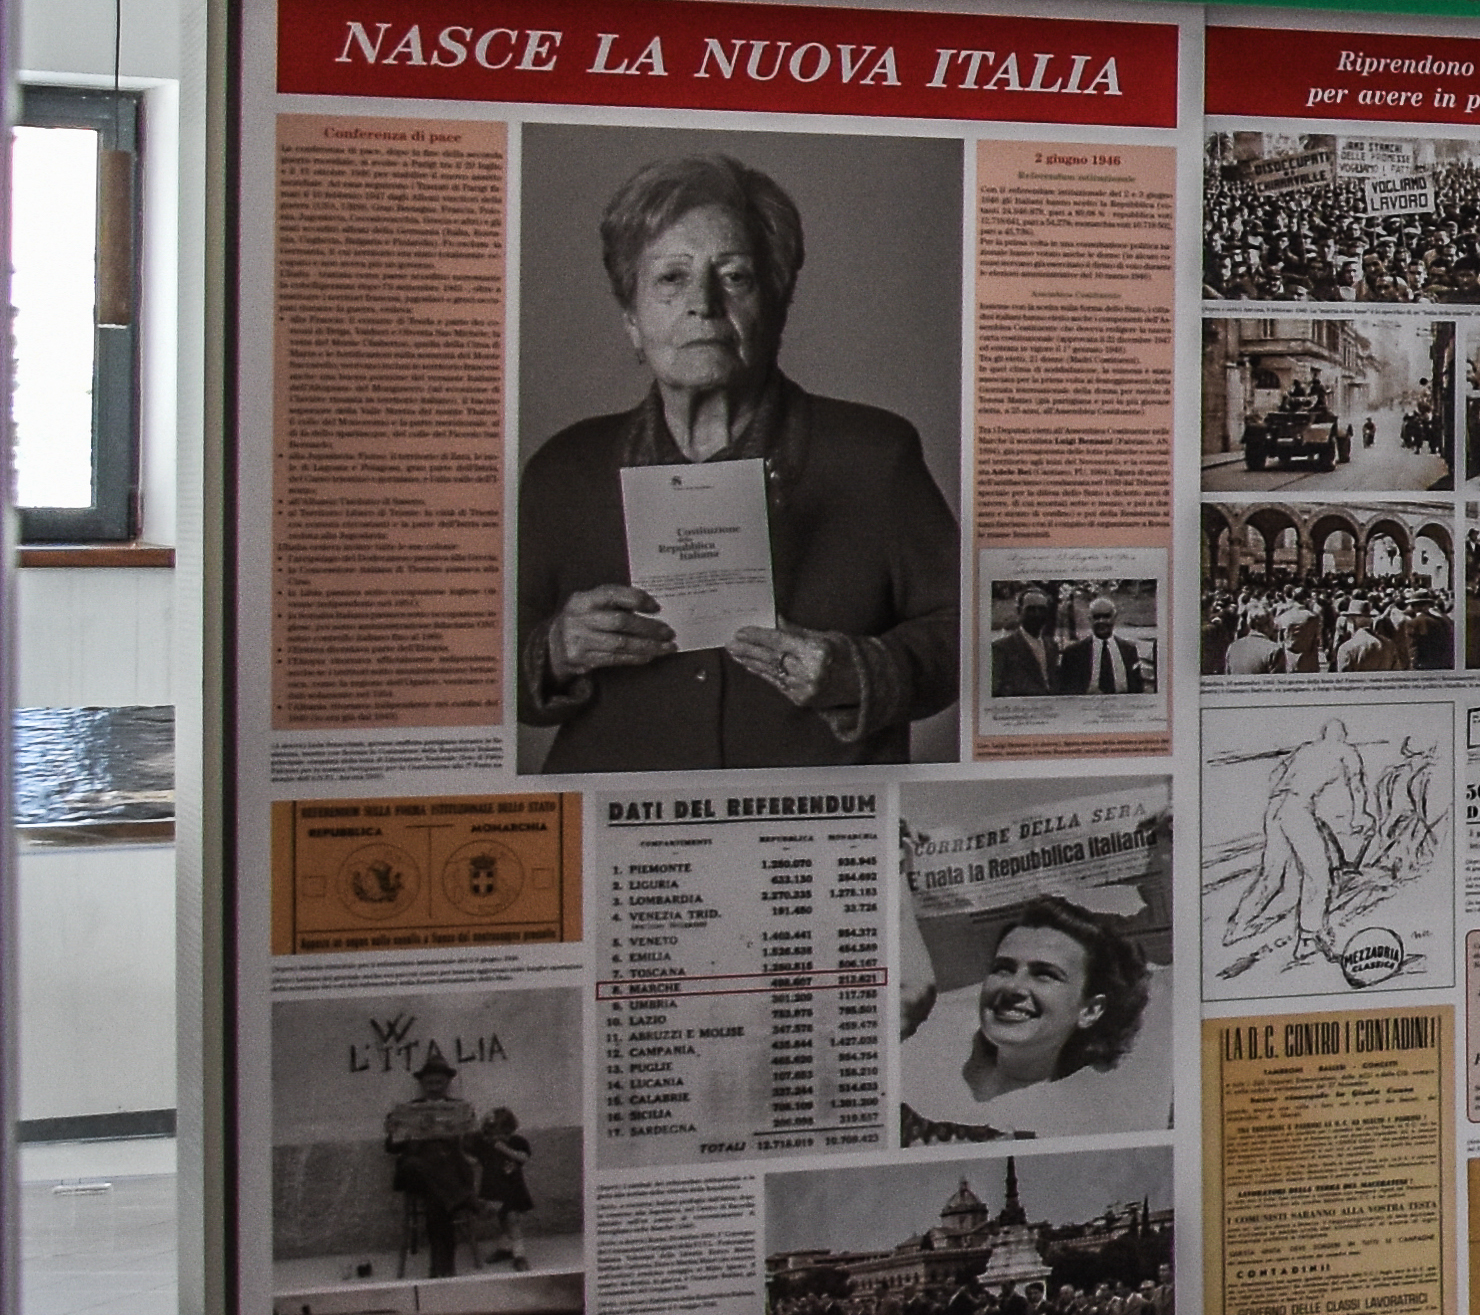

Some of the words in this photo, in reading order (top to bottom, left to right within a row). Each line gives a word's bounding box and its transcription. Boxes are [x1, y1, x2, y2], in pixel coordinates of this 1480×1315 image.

[334, 21, 562, 71] NASCE
[586, 33, 668, 76] LA
[693, 38, 901, 86] NUOVA
[925, 49, 1122, 95] ITALIA
[1336, 50, 1474, 76] Riprendono
[1305, 87, 1349, 107] per
[1358, 89, 1423, 107] avere
[1433, 87, 1455, 108] in
[1371, 177, 1427, 194] VOGLIAMO
[1370, 192, 1428, 209] LAVORO
[608, 801, 662, 821] DATI
[674, 798, 715, 819] DEL
[726, 794, 876, 817] REFERENDUM
[914, 828, 1010, 857] CORRIERE
[1020, 813, 1080, 839] DELLA
[1091, 802, 1146, 824] SERA
